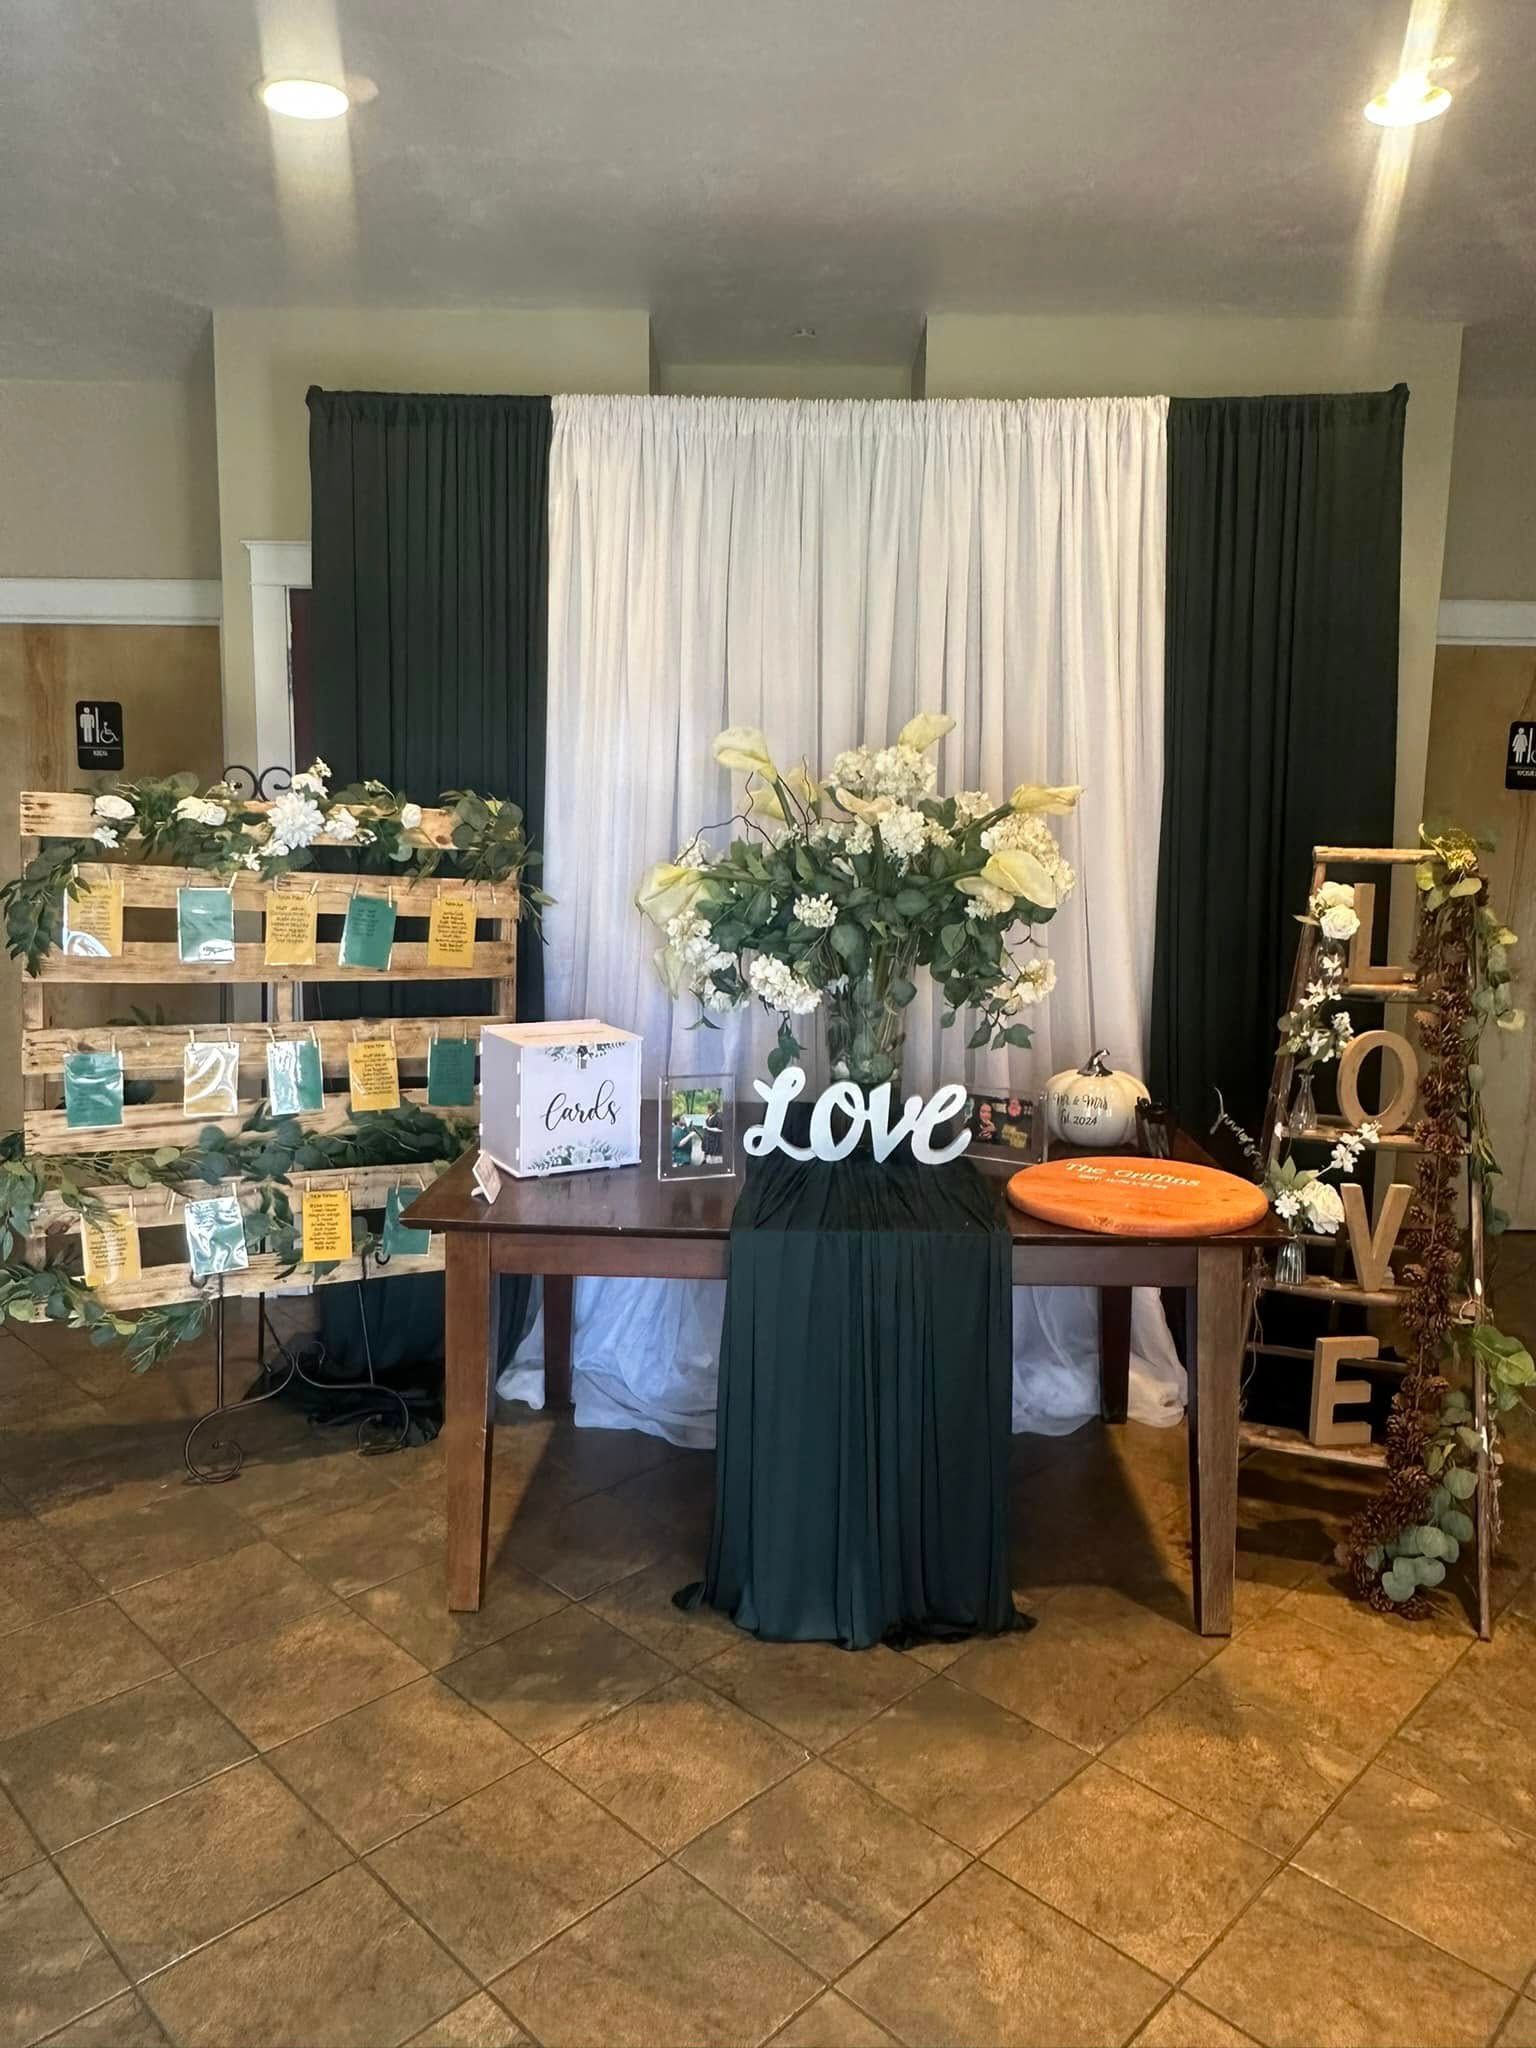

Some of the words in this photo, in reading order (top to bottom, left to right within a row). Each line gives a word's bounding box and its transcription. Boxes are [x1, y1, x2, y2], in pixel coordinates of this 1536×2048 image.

[540, 1079, 621, 1131] Cards
[1073, 1115, 1097, 1126] 2024
[1066, 1162, 1106, 1175] The
